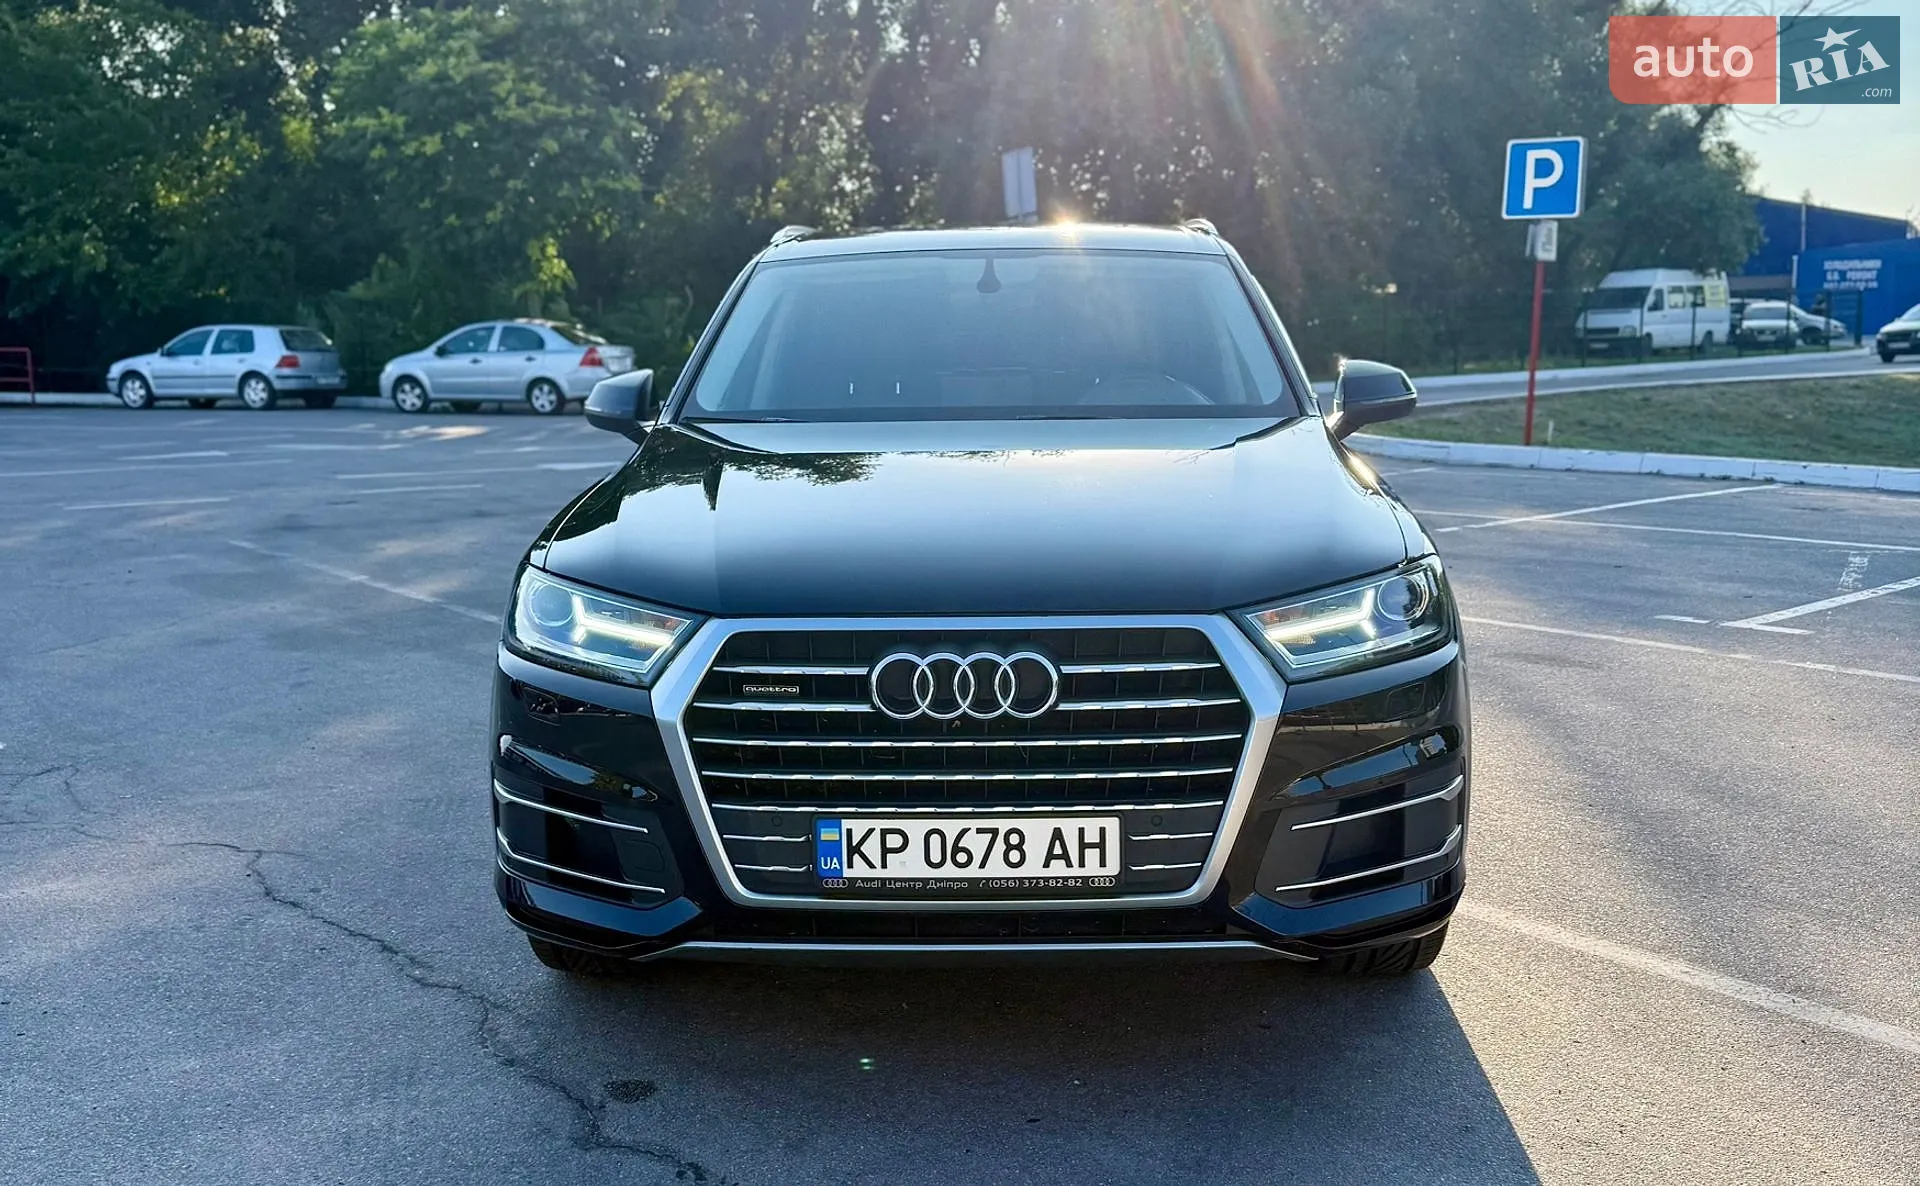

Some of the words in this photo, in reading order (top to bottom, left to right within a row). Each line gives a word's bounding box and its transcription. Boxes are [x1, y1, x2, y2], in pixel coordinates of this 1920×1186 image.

[1523, 148, 1565, 210] P
[846, 827, 910, 869] KP
[923, 827, 1027, 869] 0678
[1042, 826, 1108, 868] AH
[820, 856, 840, 870] UA
[855, 879, 881, 888] Audi
[886, 880, 923, 889] Центр
[926, 879, 968, 889] Дніпро
[989, 879, 1020, 889] (056)
[1023, 879, 1082, 888] 373-82-82
